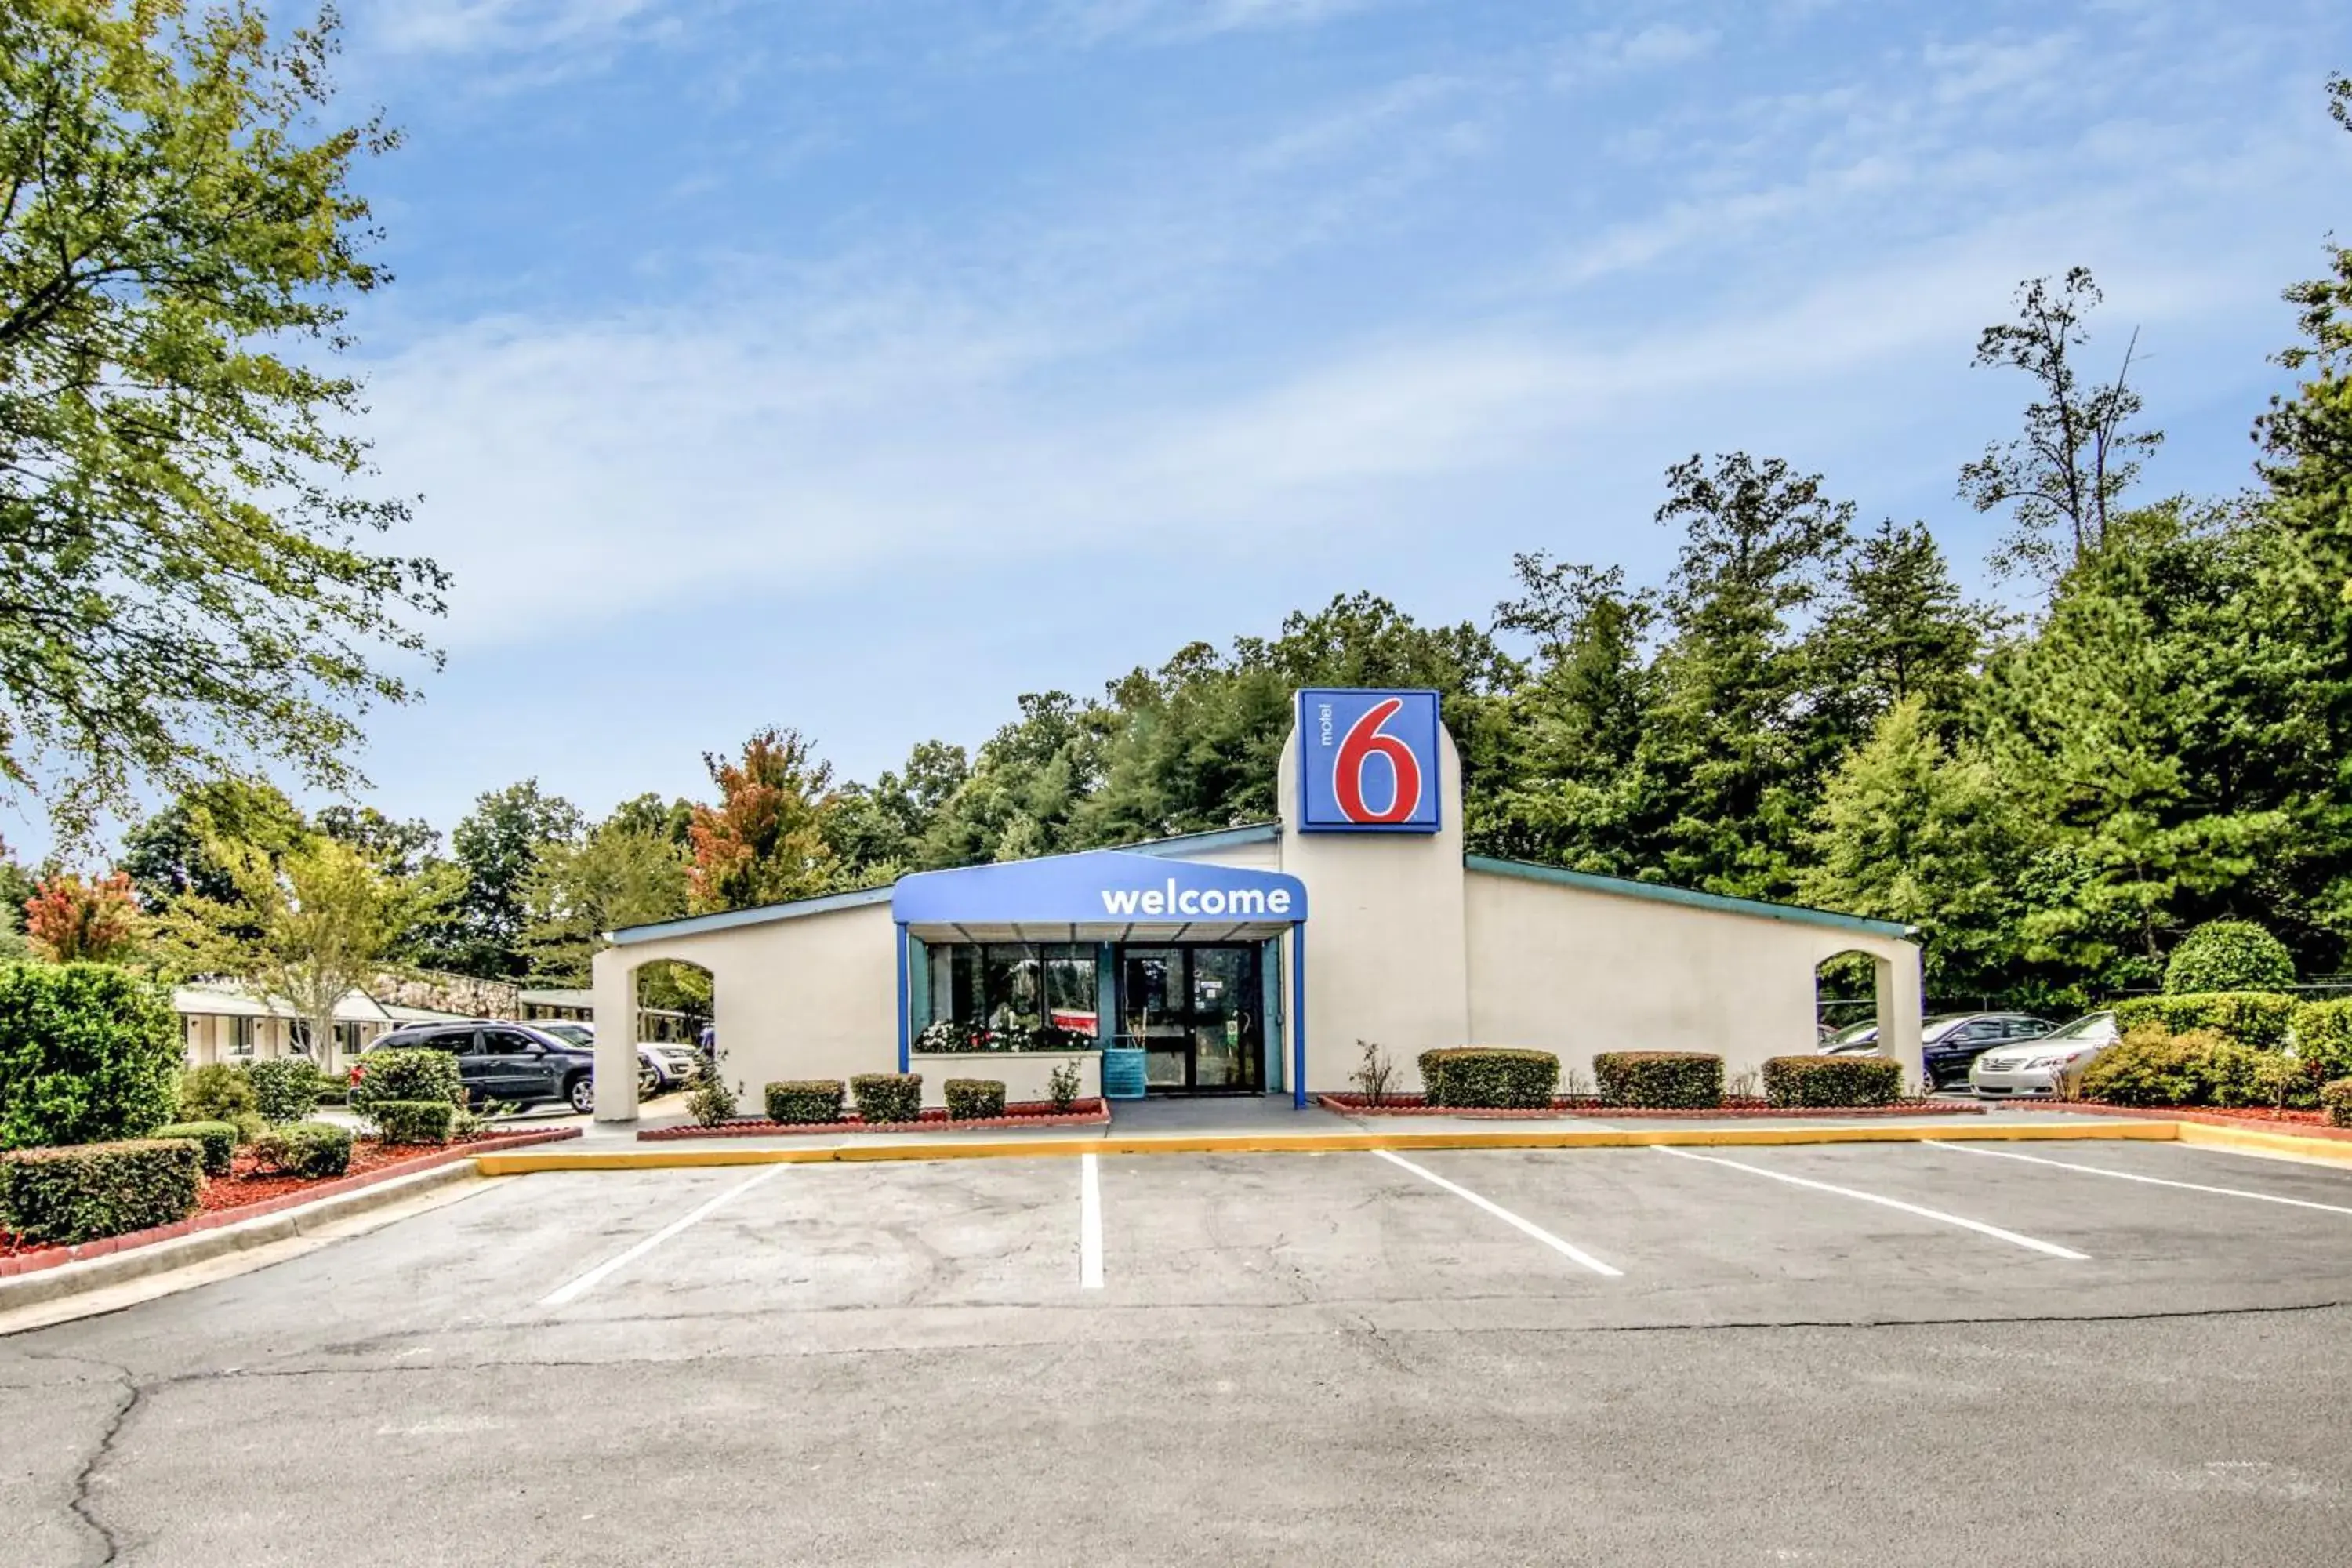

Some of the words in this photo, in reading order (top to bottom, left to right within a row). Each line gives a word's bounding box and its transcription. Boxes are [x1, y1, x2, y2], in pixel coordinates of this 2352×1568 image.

[1318, 703, 1333, 746] motel
[1332, 696, 1422, 823] 6
[1101, 877, 1291, 915] welcome
